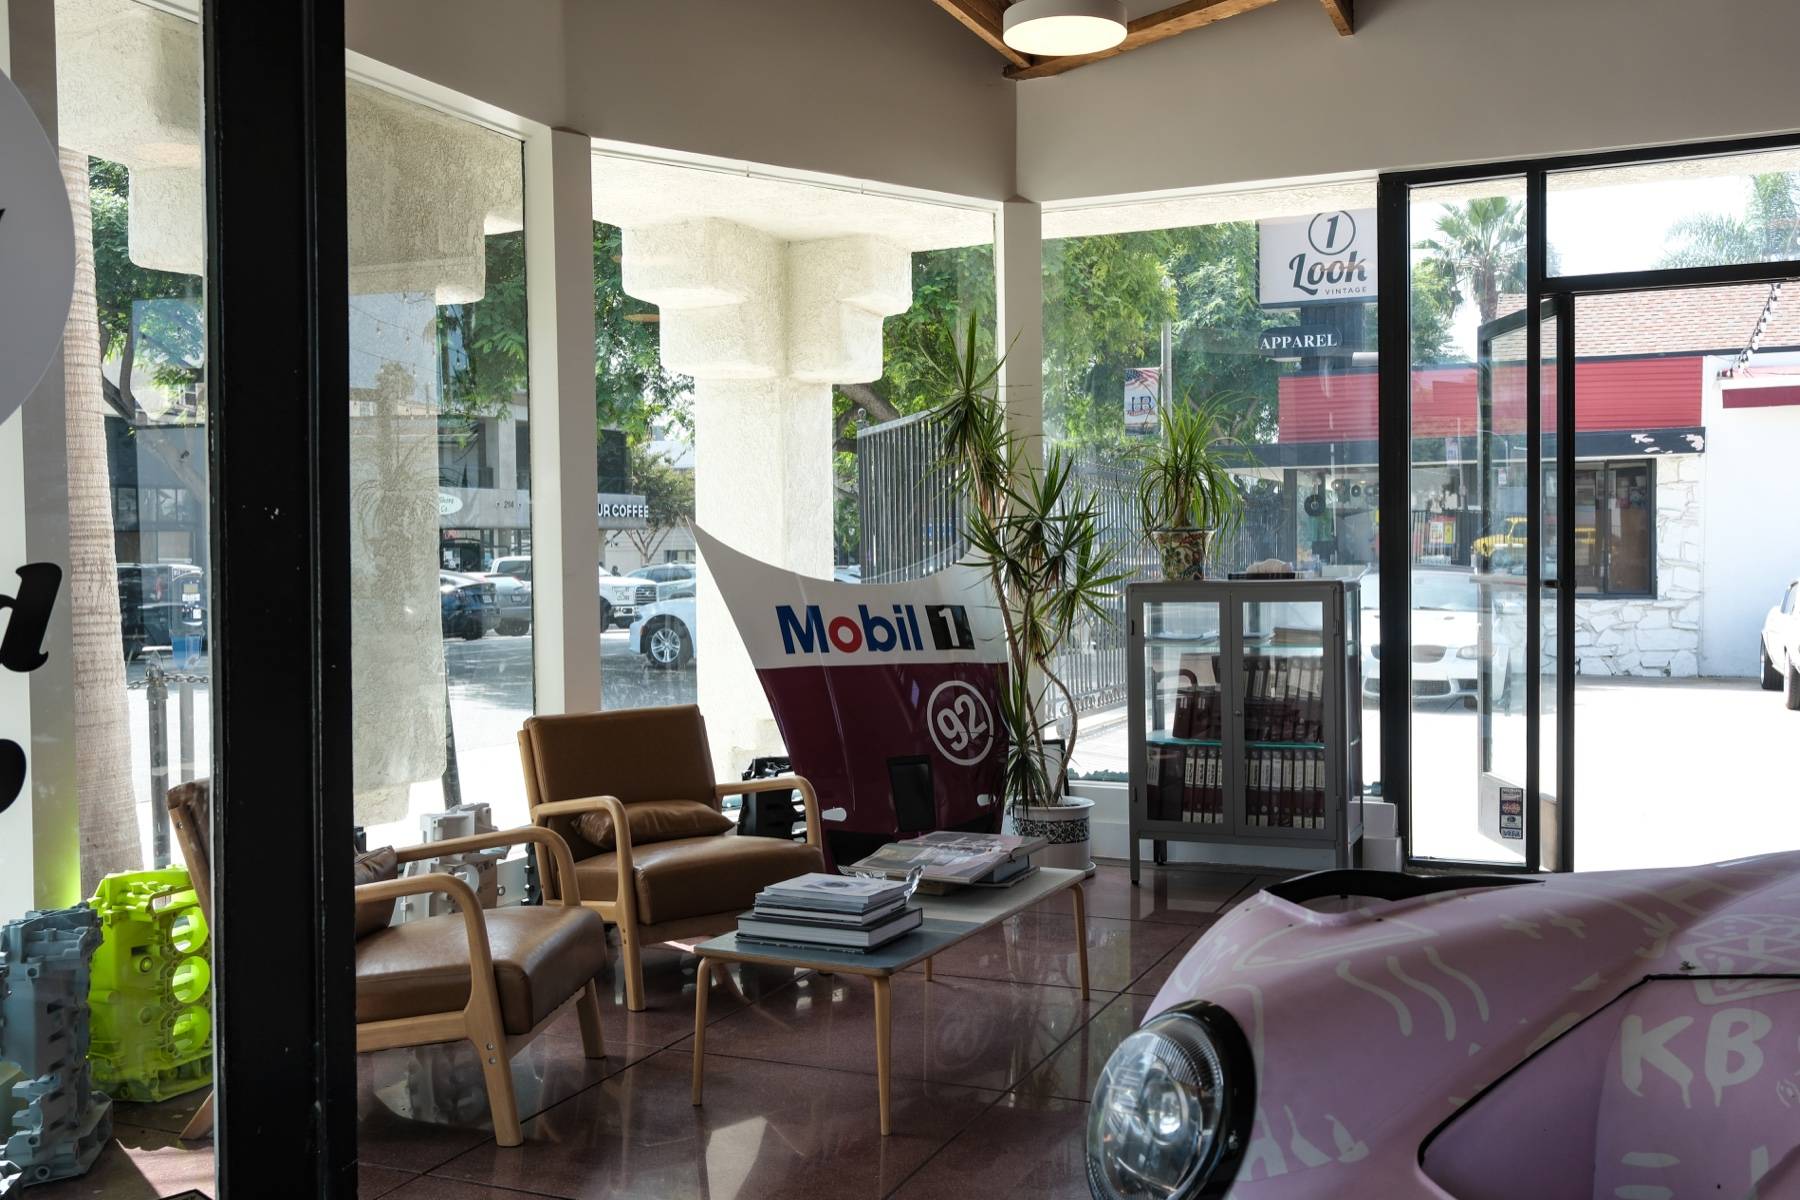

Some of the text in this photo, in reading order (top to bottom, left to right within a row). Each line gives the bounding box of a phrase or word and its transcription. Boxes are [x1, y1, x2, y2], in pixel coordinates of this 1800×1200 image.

[1326, 215, 1339, 249] 1
[1288, 250, 1368, 296] Look
[1324, 286, 1368, 296] VINTAGE
[1260, 333, 1338, 350] APPAREL
[611, 503, 649, 519] COFFEE
[775, 604, 924, 654] Mobil
[936, 693, 988, 752] 92
